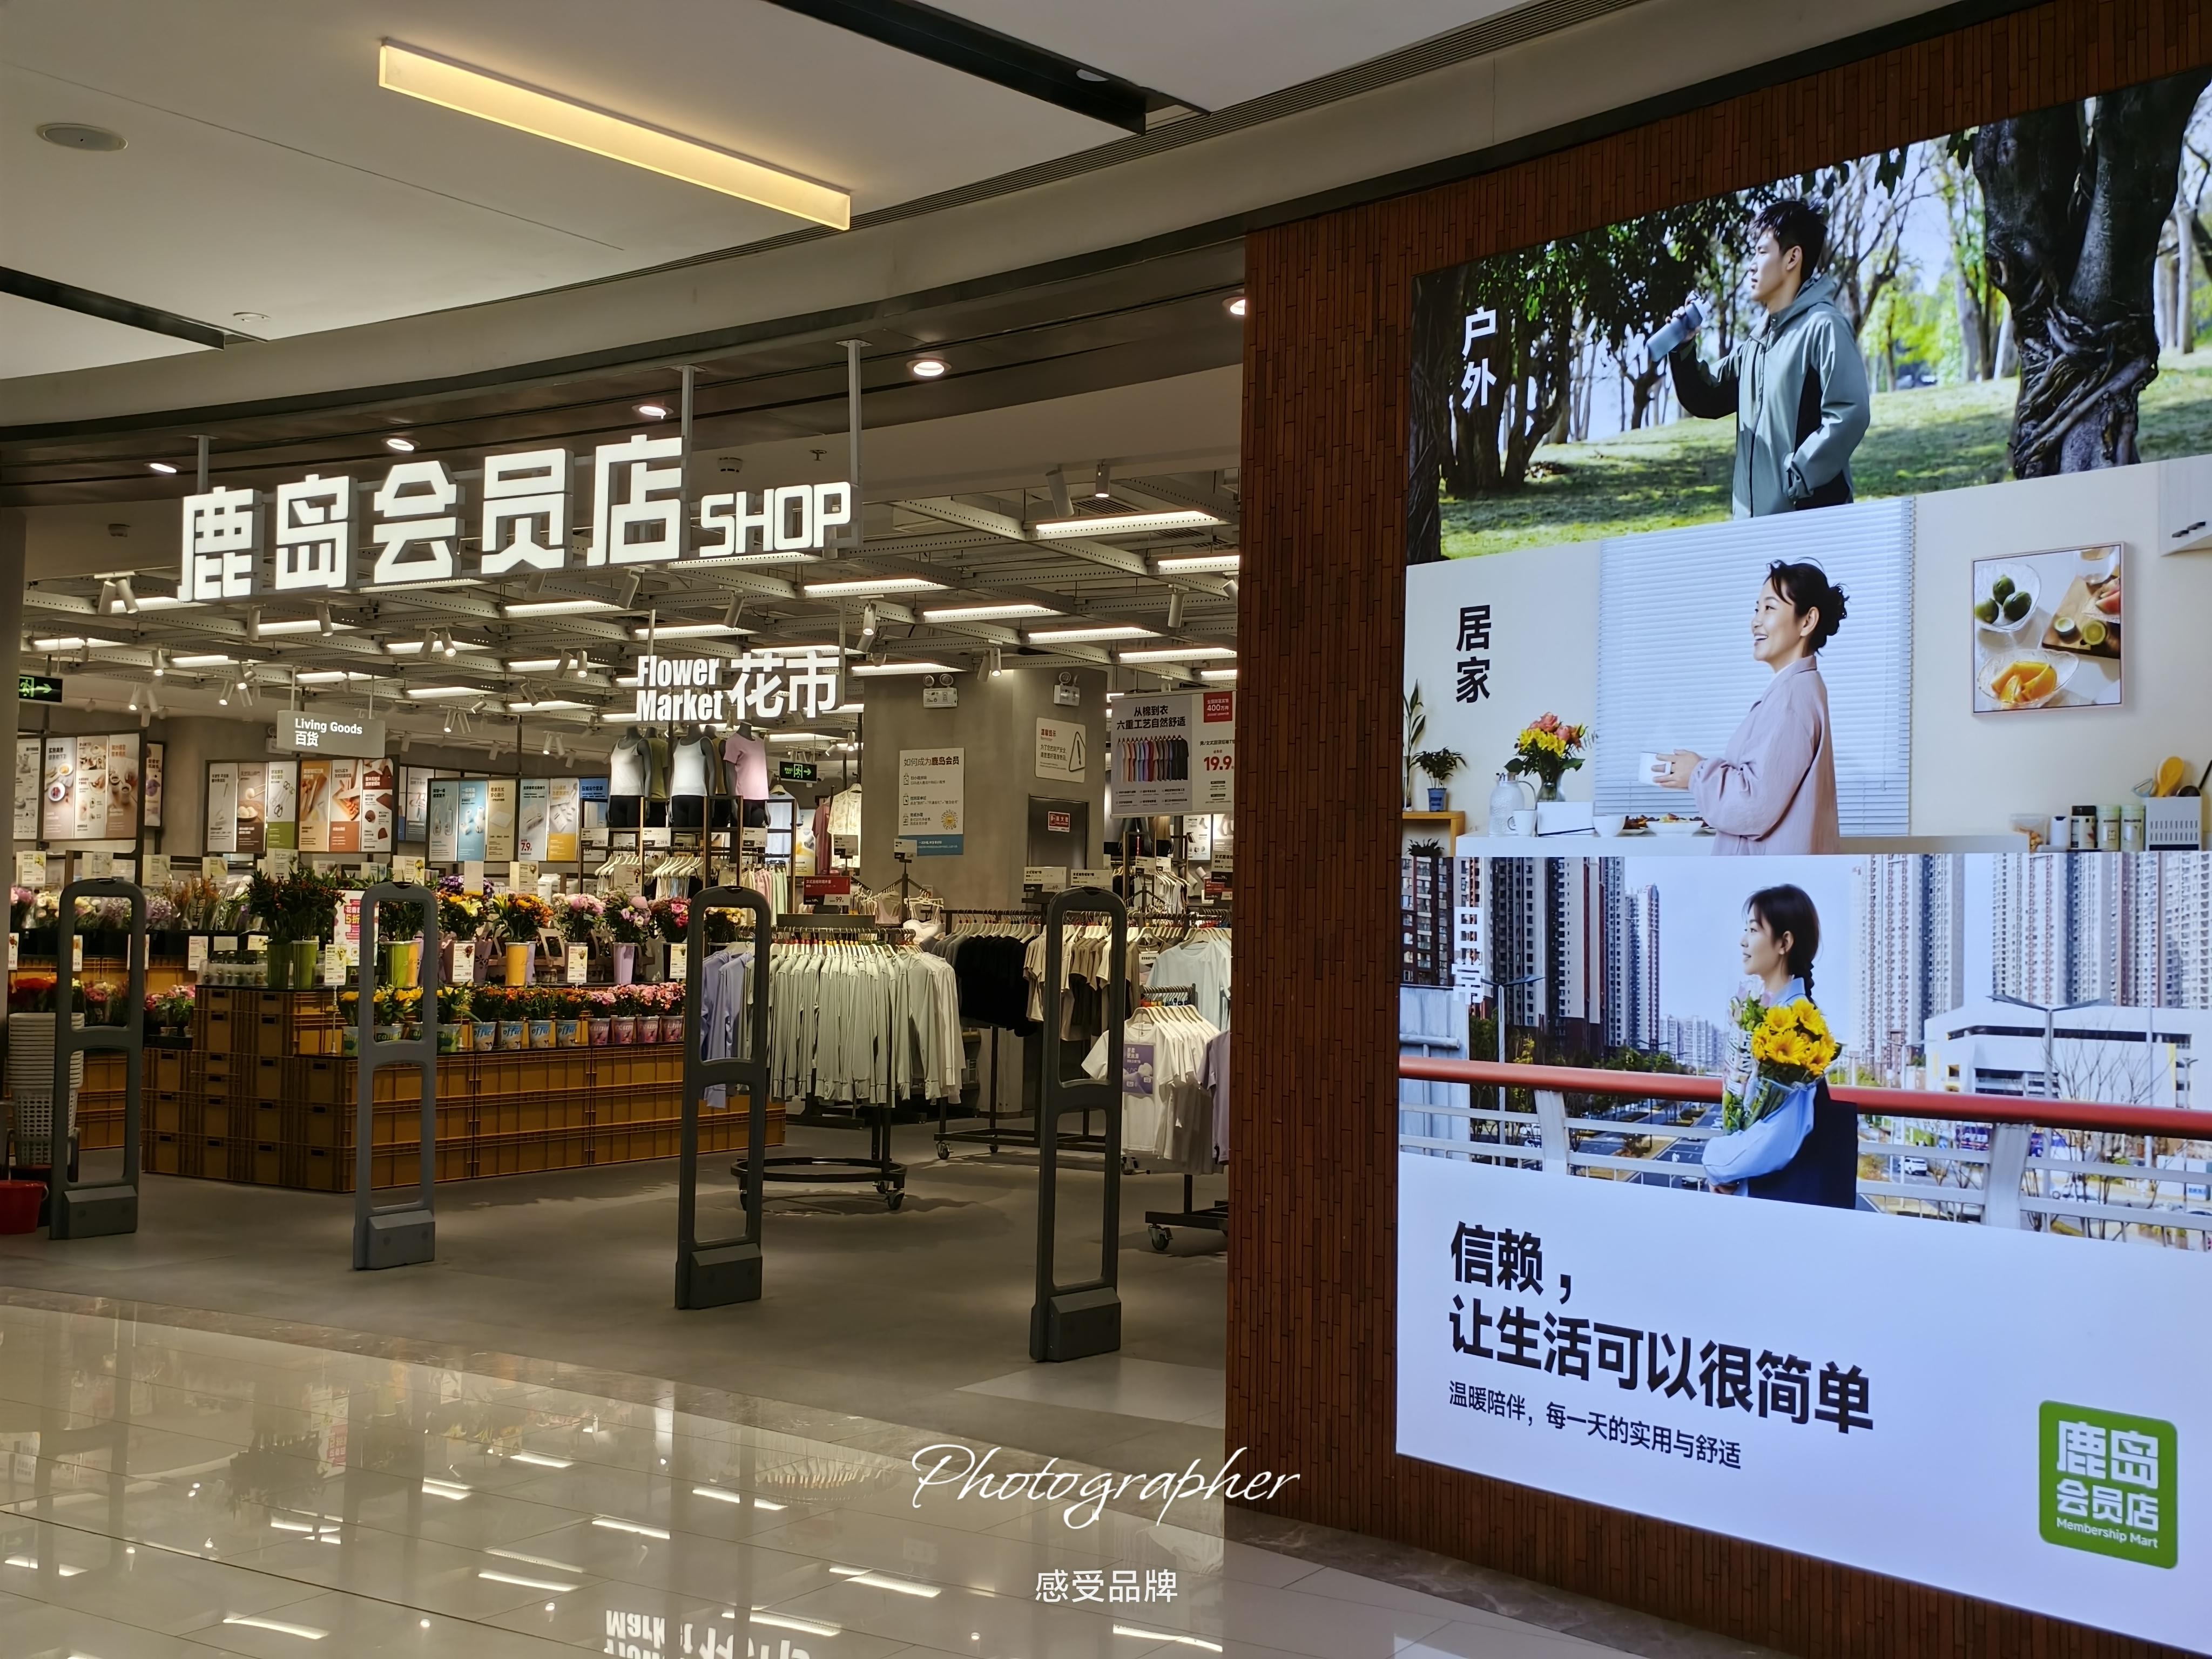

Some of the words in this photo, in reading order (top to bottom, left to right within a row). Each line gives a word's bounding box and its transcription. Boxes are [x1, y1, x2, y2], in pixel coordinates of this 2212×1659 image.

[1461, 306, 1497, 409] 户外
[177, 434, 682, 602] 鹿岛会员店
[699, 482, 851, 557] SHOP
[638, 655, 719, 687] Flower
[1456, 605, 1492, 703] 居家
[636, 690, 723, 721] Market
[729, 650, 840, 719] 花市
[1134, 705, 1169, 717] 从棉到衣
[295, 718, 327, 733] Living
[330, 721, 362, 734] Goods
[295, 730, 319, 747] 百货
[1117, 716, 1186, 730] 六重工艺自然舒适
[903, 756, 960, 767] 如何成为鹿岛会员
[1451, 906, 1485, 1006] 日常
[1449, 1294, 1874, 1435] 让生活可以很简单
[1449, 1380, 1742, 1469] 温暖陪伴，每一天的实用与舒适
[2056, 1420, 2159, 1489] 鹿岛
[2056, 1478, 2159, 1532] 会员店
[2056, 1517, 2127, 1543] Membership
[2129, 1532, 2159, 1549] Mart
